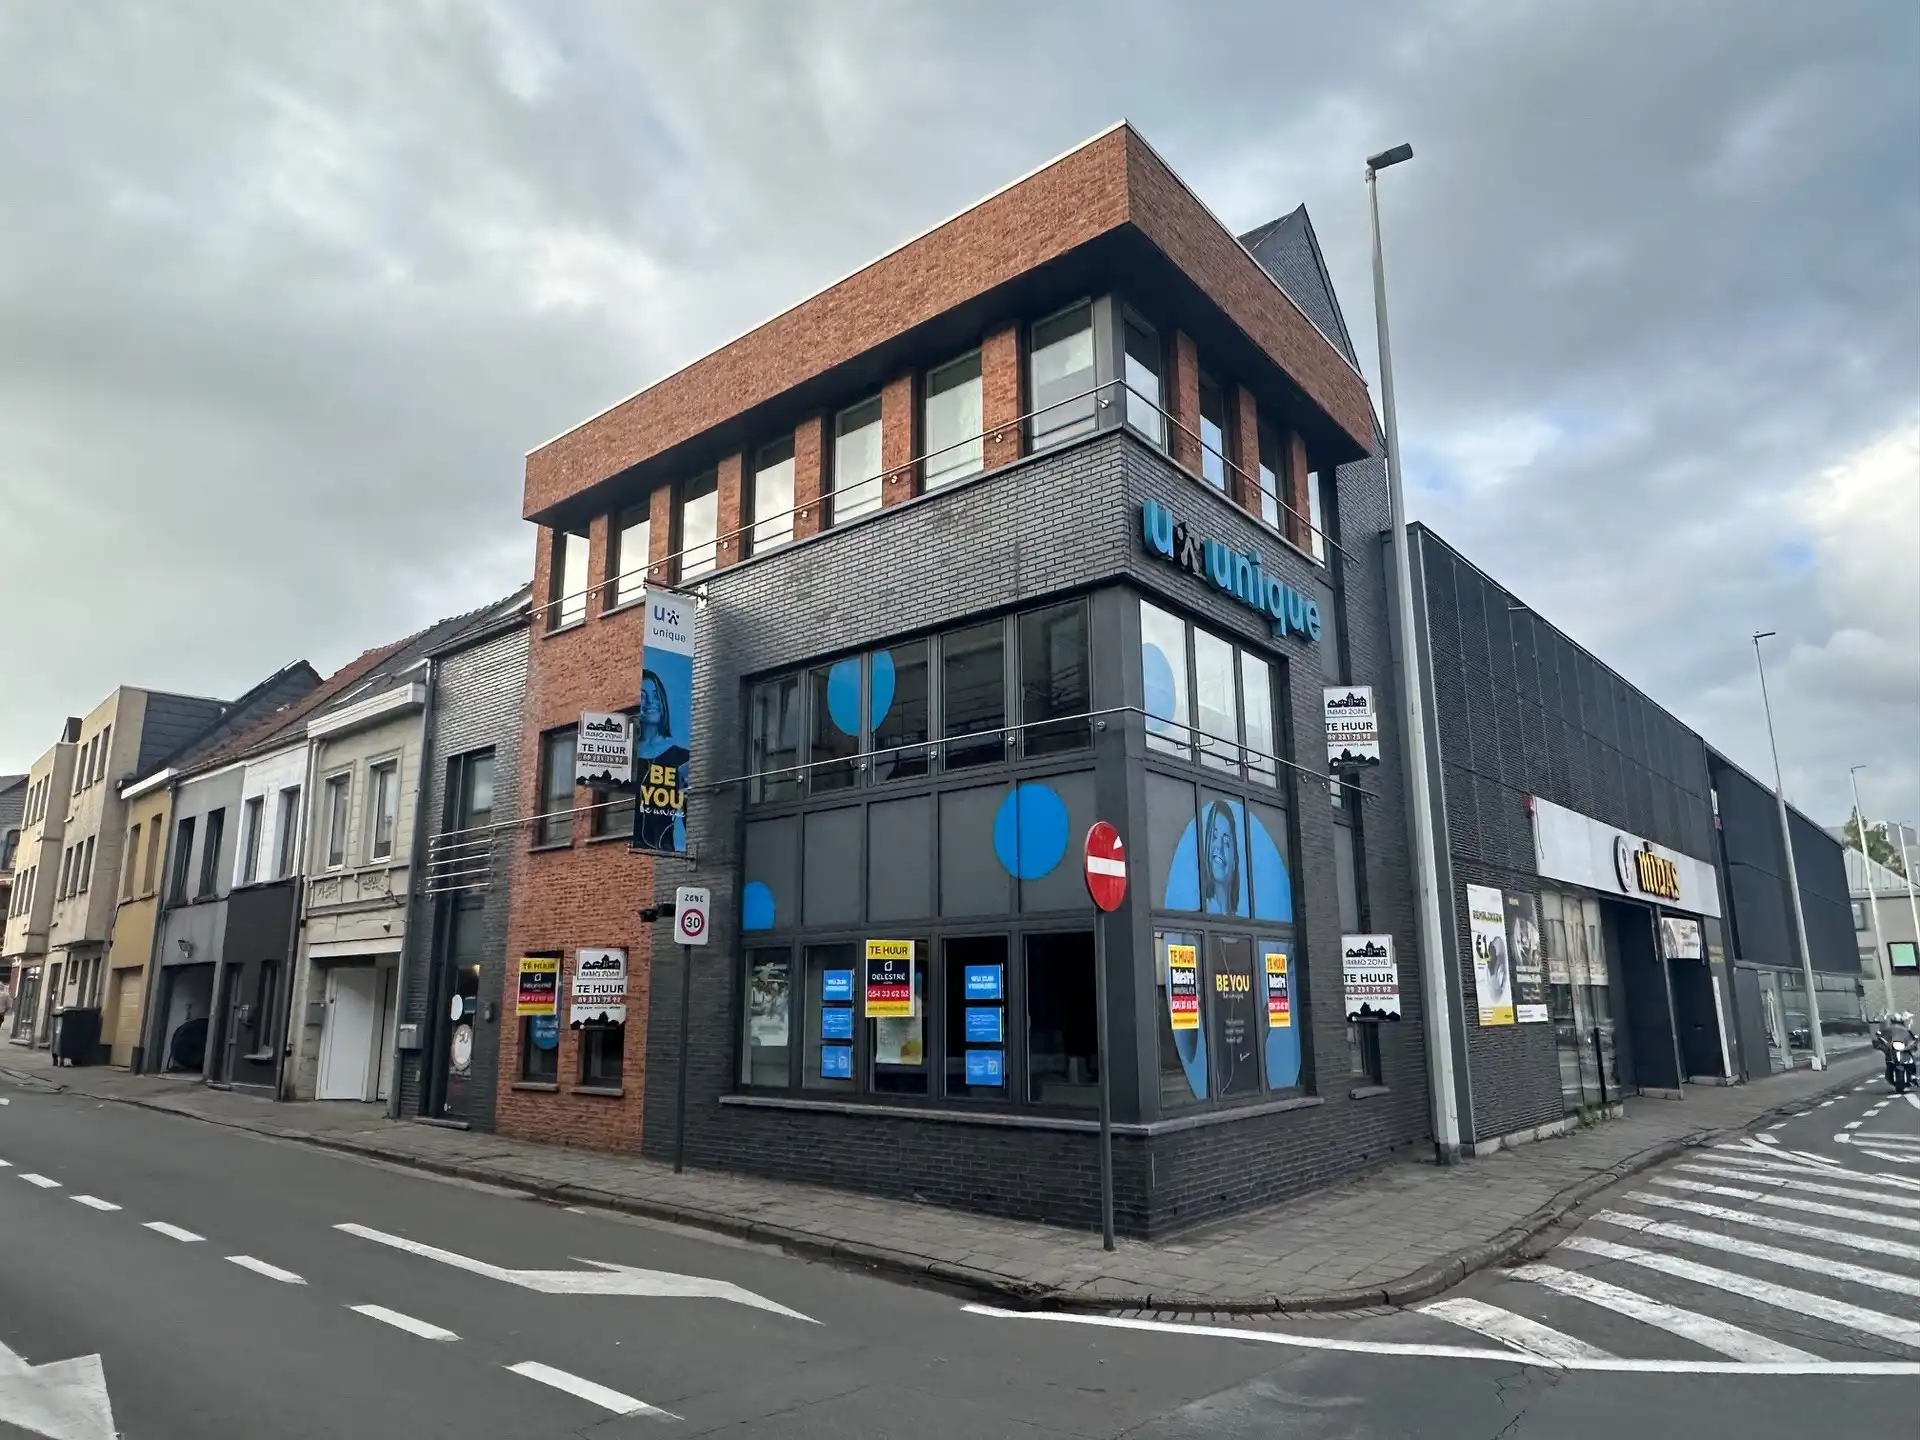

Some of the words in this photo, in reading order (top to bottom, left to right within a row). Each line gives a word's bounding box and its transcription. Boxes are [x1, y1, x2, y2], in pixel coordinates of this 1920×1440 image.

[1202, 538, 1321, 642] unique
[653, 627, 686, 642] unique
[1326, 723, 1338, 731] TE
[1341, 722, 1373, 730] HUUR
[582, 743, 594, 752] TE
[597, 744, 626, 755] HUUR
[650, 764, 677, 787] BE
[640, 785, 685, 809] YOU
[685, 894, 704, 902] ZONE
[686, 917, 700, 928] 30
[870, 946, 881, 954] TE
[883, 946, 908, 955] HUUR
[1170, 950, 1178, 963] TE
[1216, 974, 1229, 992] BE
[1230, 975, 1250, 992] YOU
[1344, 974, 1356, 982] TE
[1360, 974, 1394, 982] HUUR
[576, 985, 590, 993] TE
[593, 985, 624, 993] HUUR
